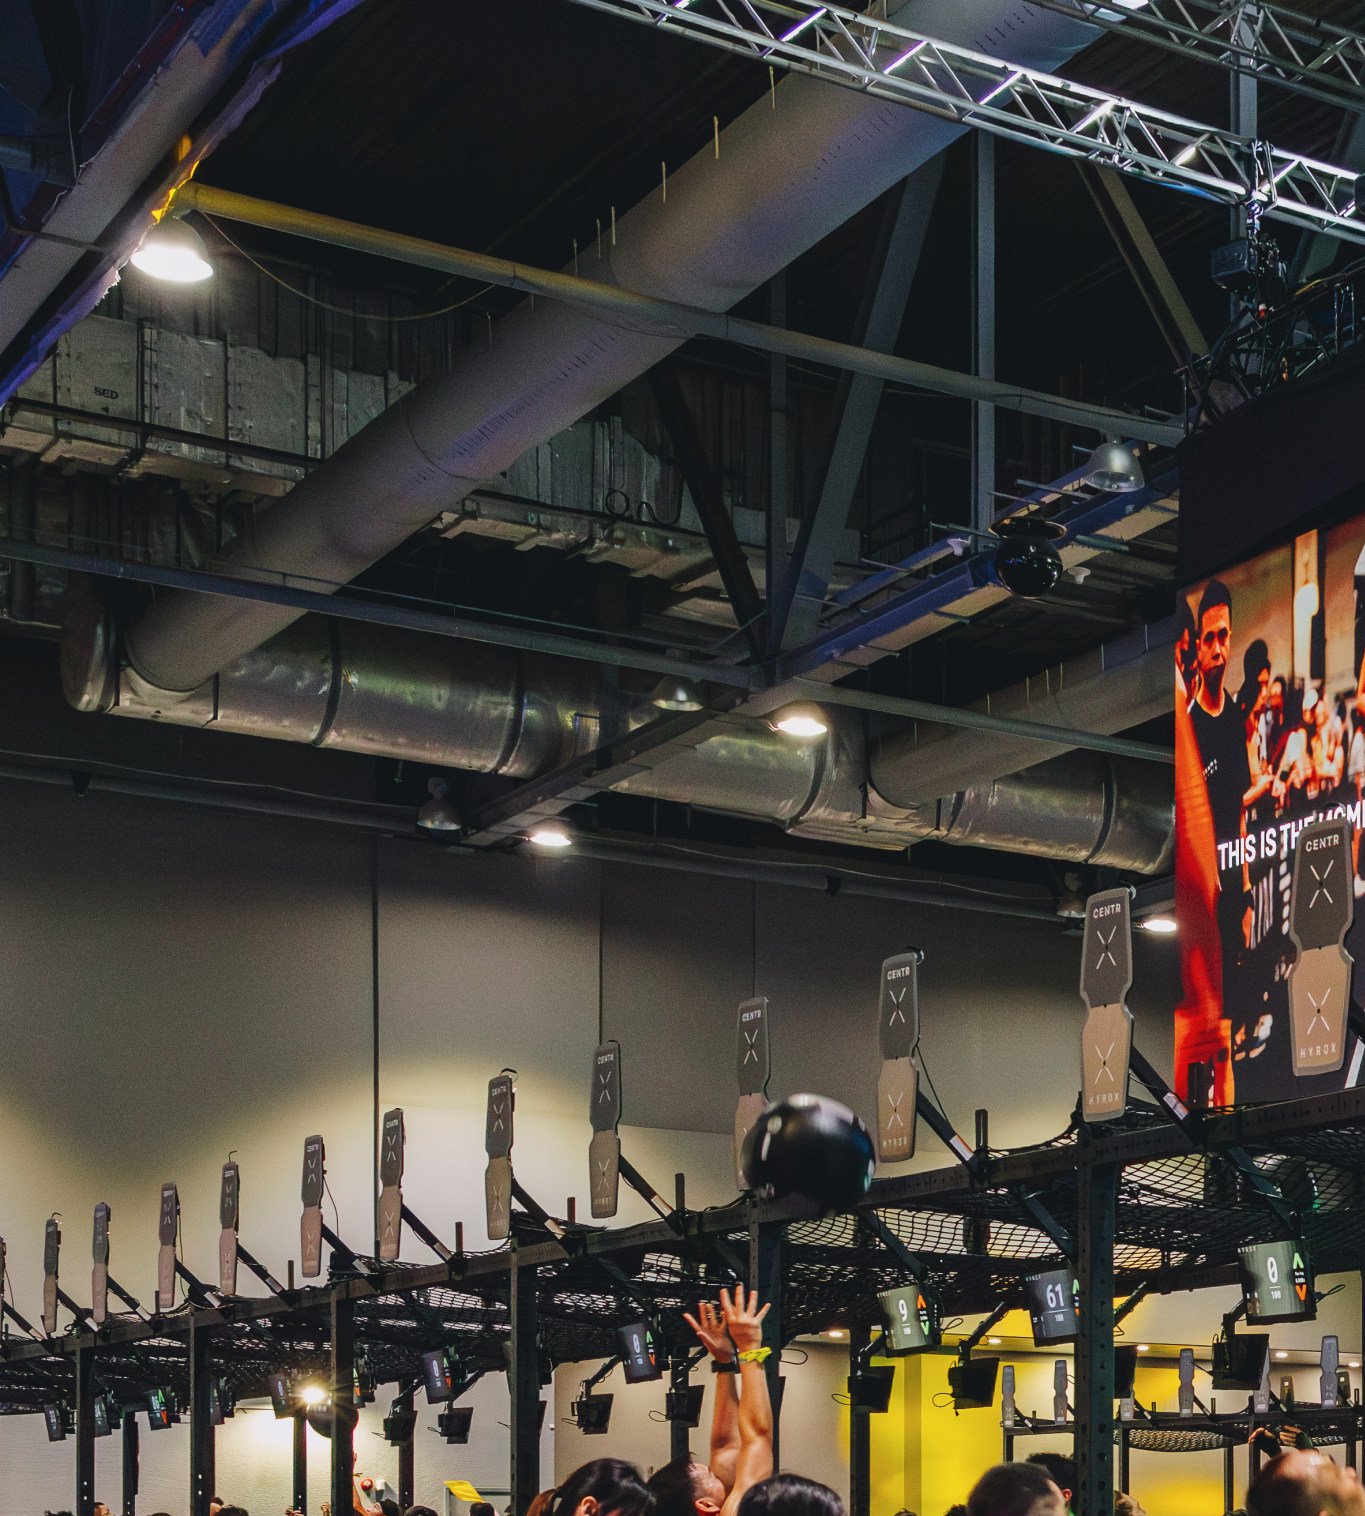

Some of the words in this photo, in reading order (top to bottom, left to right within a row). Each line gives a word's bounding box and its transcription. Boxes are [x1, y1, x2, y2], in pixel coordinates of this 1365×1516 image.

[1217, 835, 1256, 871] THIS
[1260, 827, 1277, 860] IS
[1305, 834, 1340, 853] CENTR
[1092, 903, 1121, 919] CENTR
[887, 966, 911, 980] CENTR
[1299, 1043, 1337, 1059] HYROX
[1089, 1092, 1120, 1106] HYROX
[1266, 1256, 1279, 1283] 0
[1045, 1282, 1065, 1309] 61
[898, 1299, 909, 1322] 9
